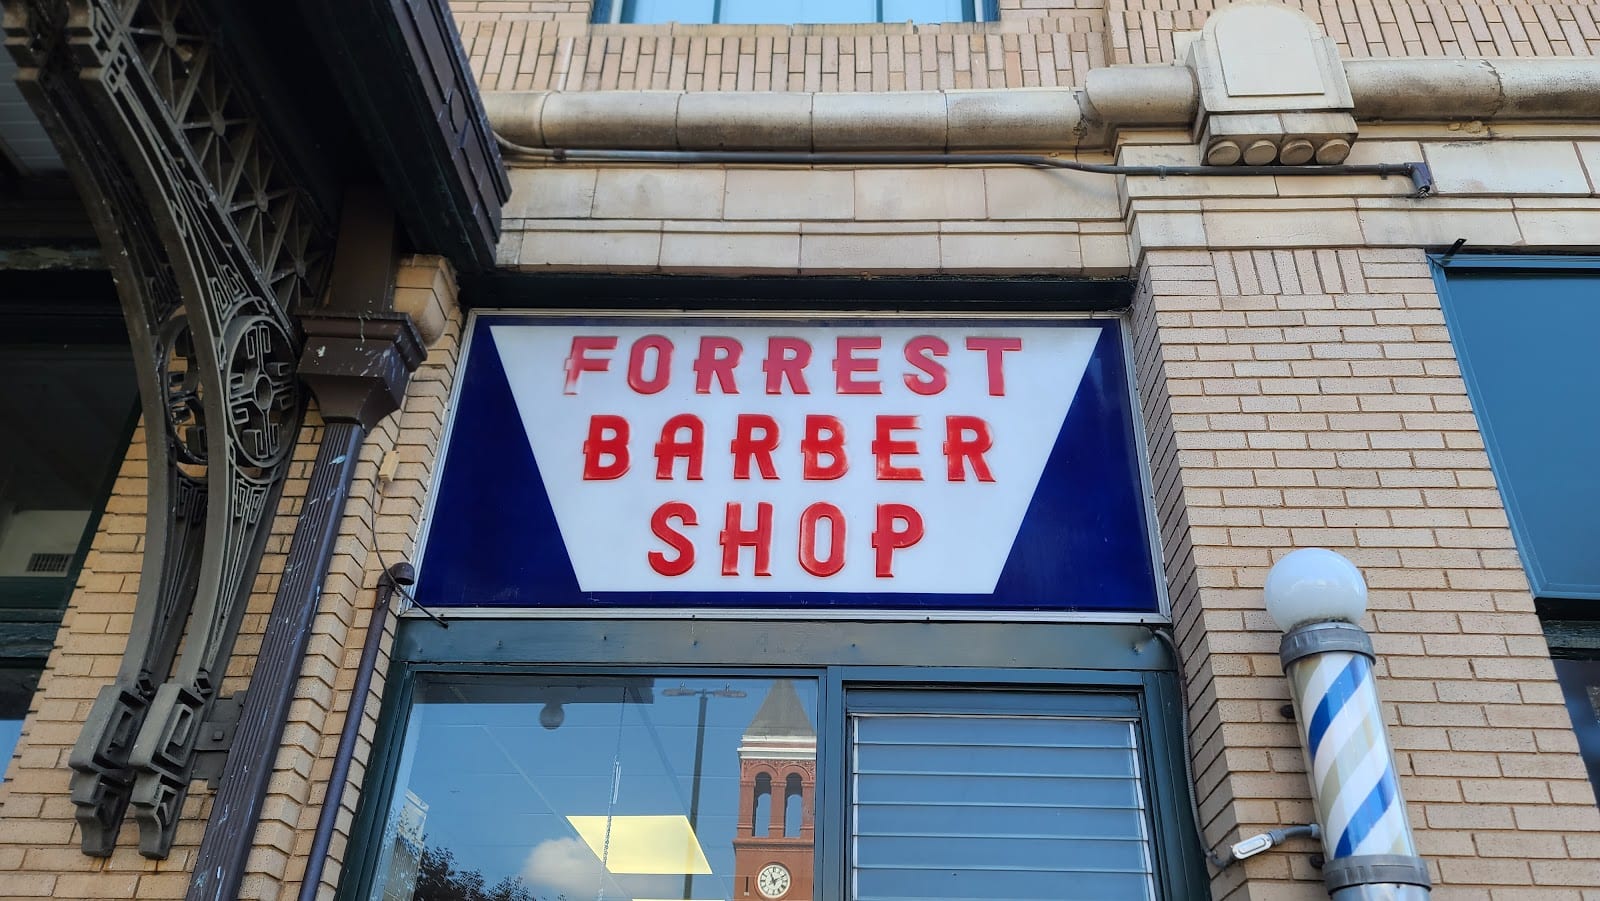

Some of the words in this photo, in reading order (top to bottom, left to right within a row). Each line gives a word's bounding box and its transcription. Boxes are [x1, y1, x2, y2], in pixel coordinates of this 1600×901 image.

[563, 335, 1022, 396] FORREST
[583, 414, 995, 481] BARBER
[648, 502, 924, 577] SHOP
